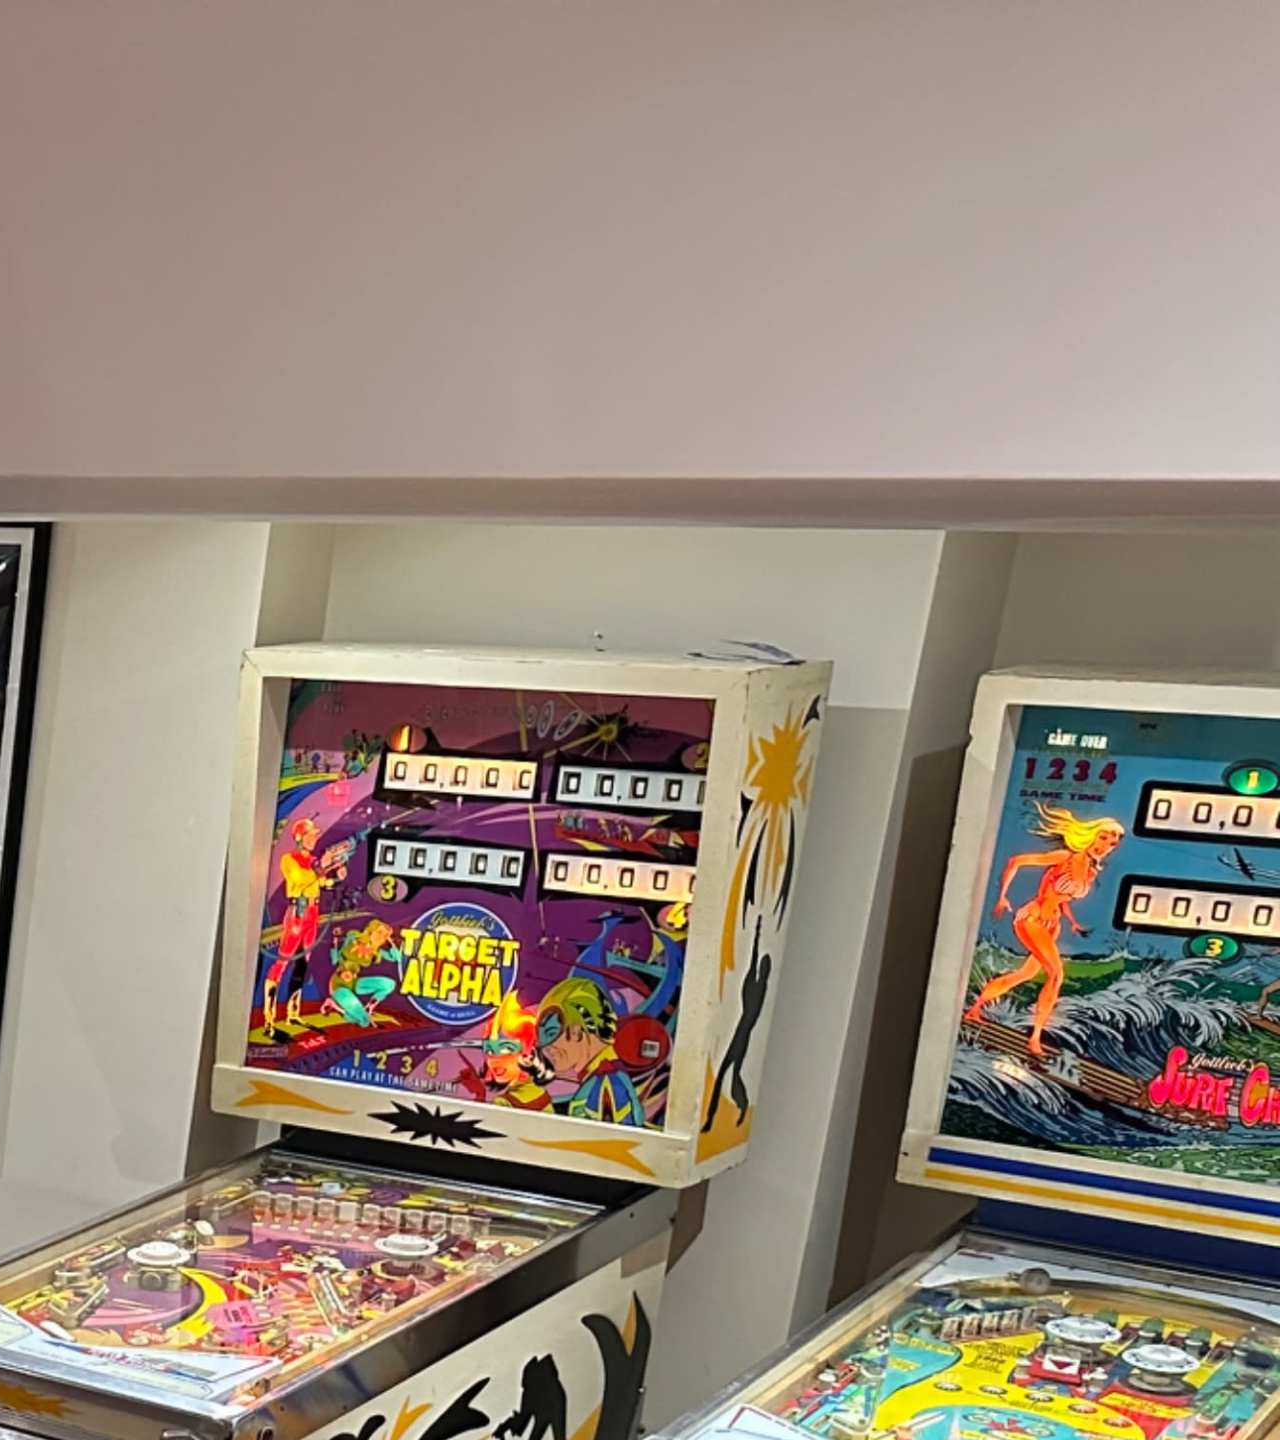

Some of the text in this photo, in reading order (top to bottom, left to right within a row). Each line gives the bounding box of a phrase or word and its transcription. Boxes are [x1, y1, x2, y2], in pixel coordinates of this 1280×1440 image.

[1026, 757, 1119, 784] 1 2 3 4
[1247, 770, 1259, 788] 1
[1020, 789, 1107, 803] SAME TIME
[380, 874, 397, 899] 3
[666, 901, 689, 929] 4
[401, 928, 520, 967] TARGET
[1205, 938, 1224, 957] 3
[400, 957, 502, 1008] ALPHA
[329, 1066, 347, 1078] CAN
[351, 1069, 372, 1081] PLAY
[375, 1072, 385, 1083] AT
[353, 1049, 438, 1078] 1 2 3 4
[1148, 1045, 1233, 1117] SURF
